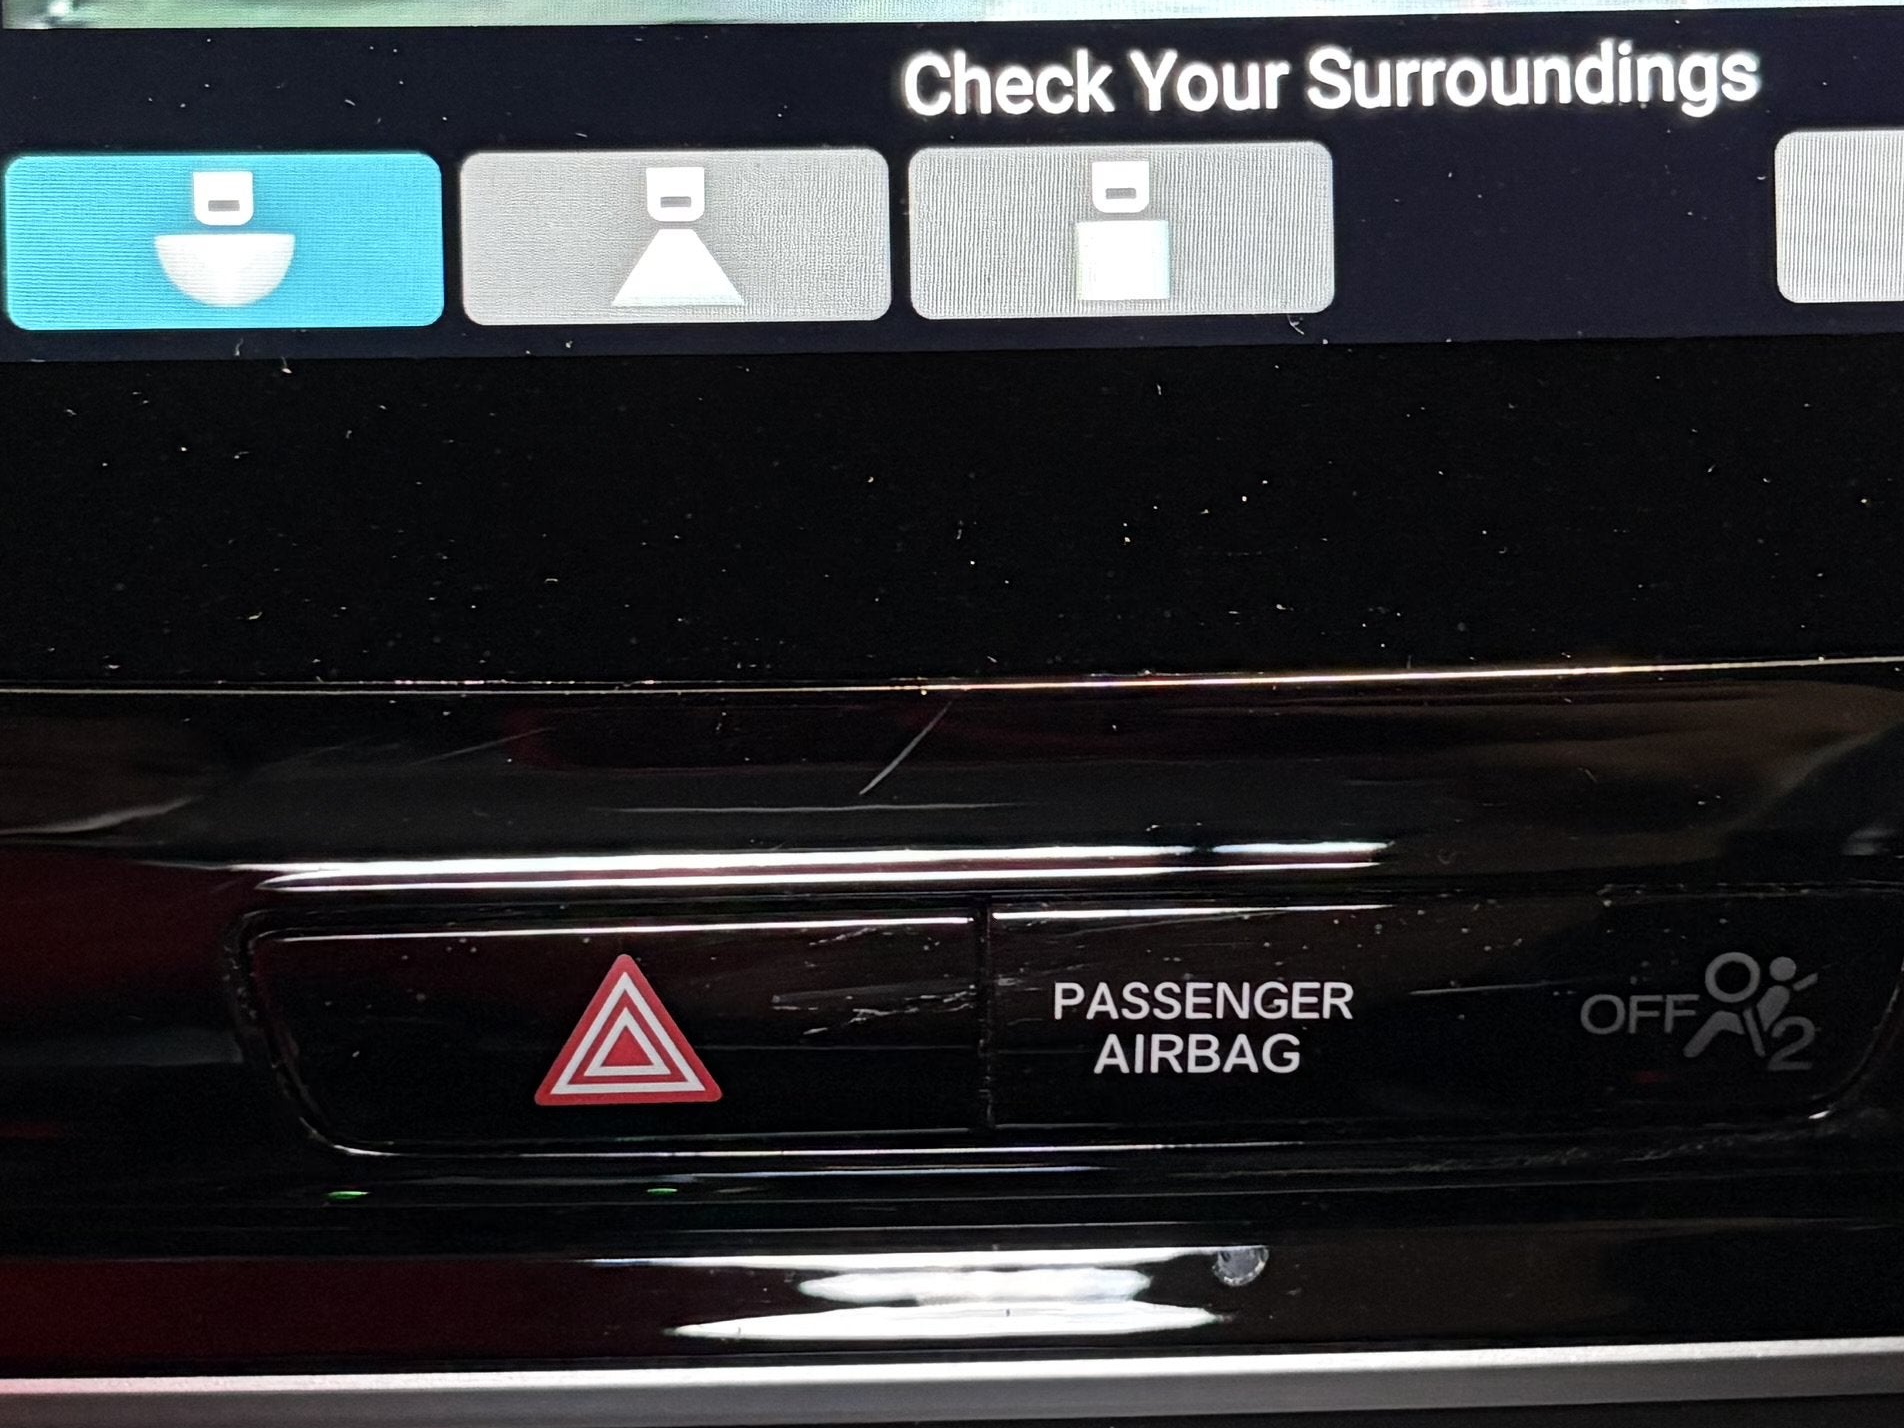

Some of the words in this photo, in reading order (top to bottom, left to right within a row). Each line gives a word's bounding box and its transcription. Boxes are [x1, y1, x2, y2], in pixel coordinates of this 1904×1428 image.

[901, 46, 1117, 118] Check
[1127, 48, 1292, 114] Your
[1305, 36, 1762, 120] Surroundings
[1053, 980, 1355, 1021] PASSENGER
[1580, 993, 1700, 1036] OFF
[1092, 1031, 1302, 1075] AIRBAG
